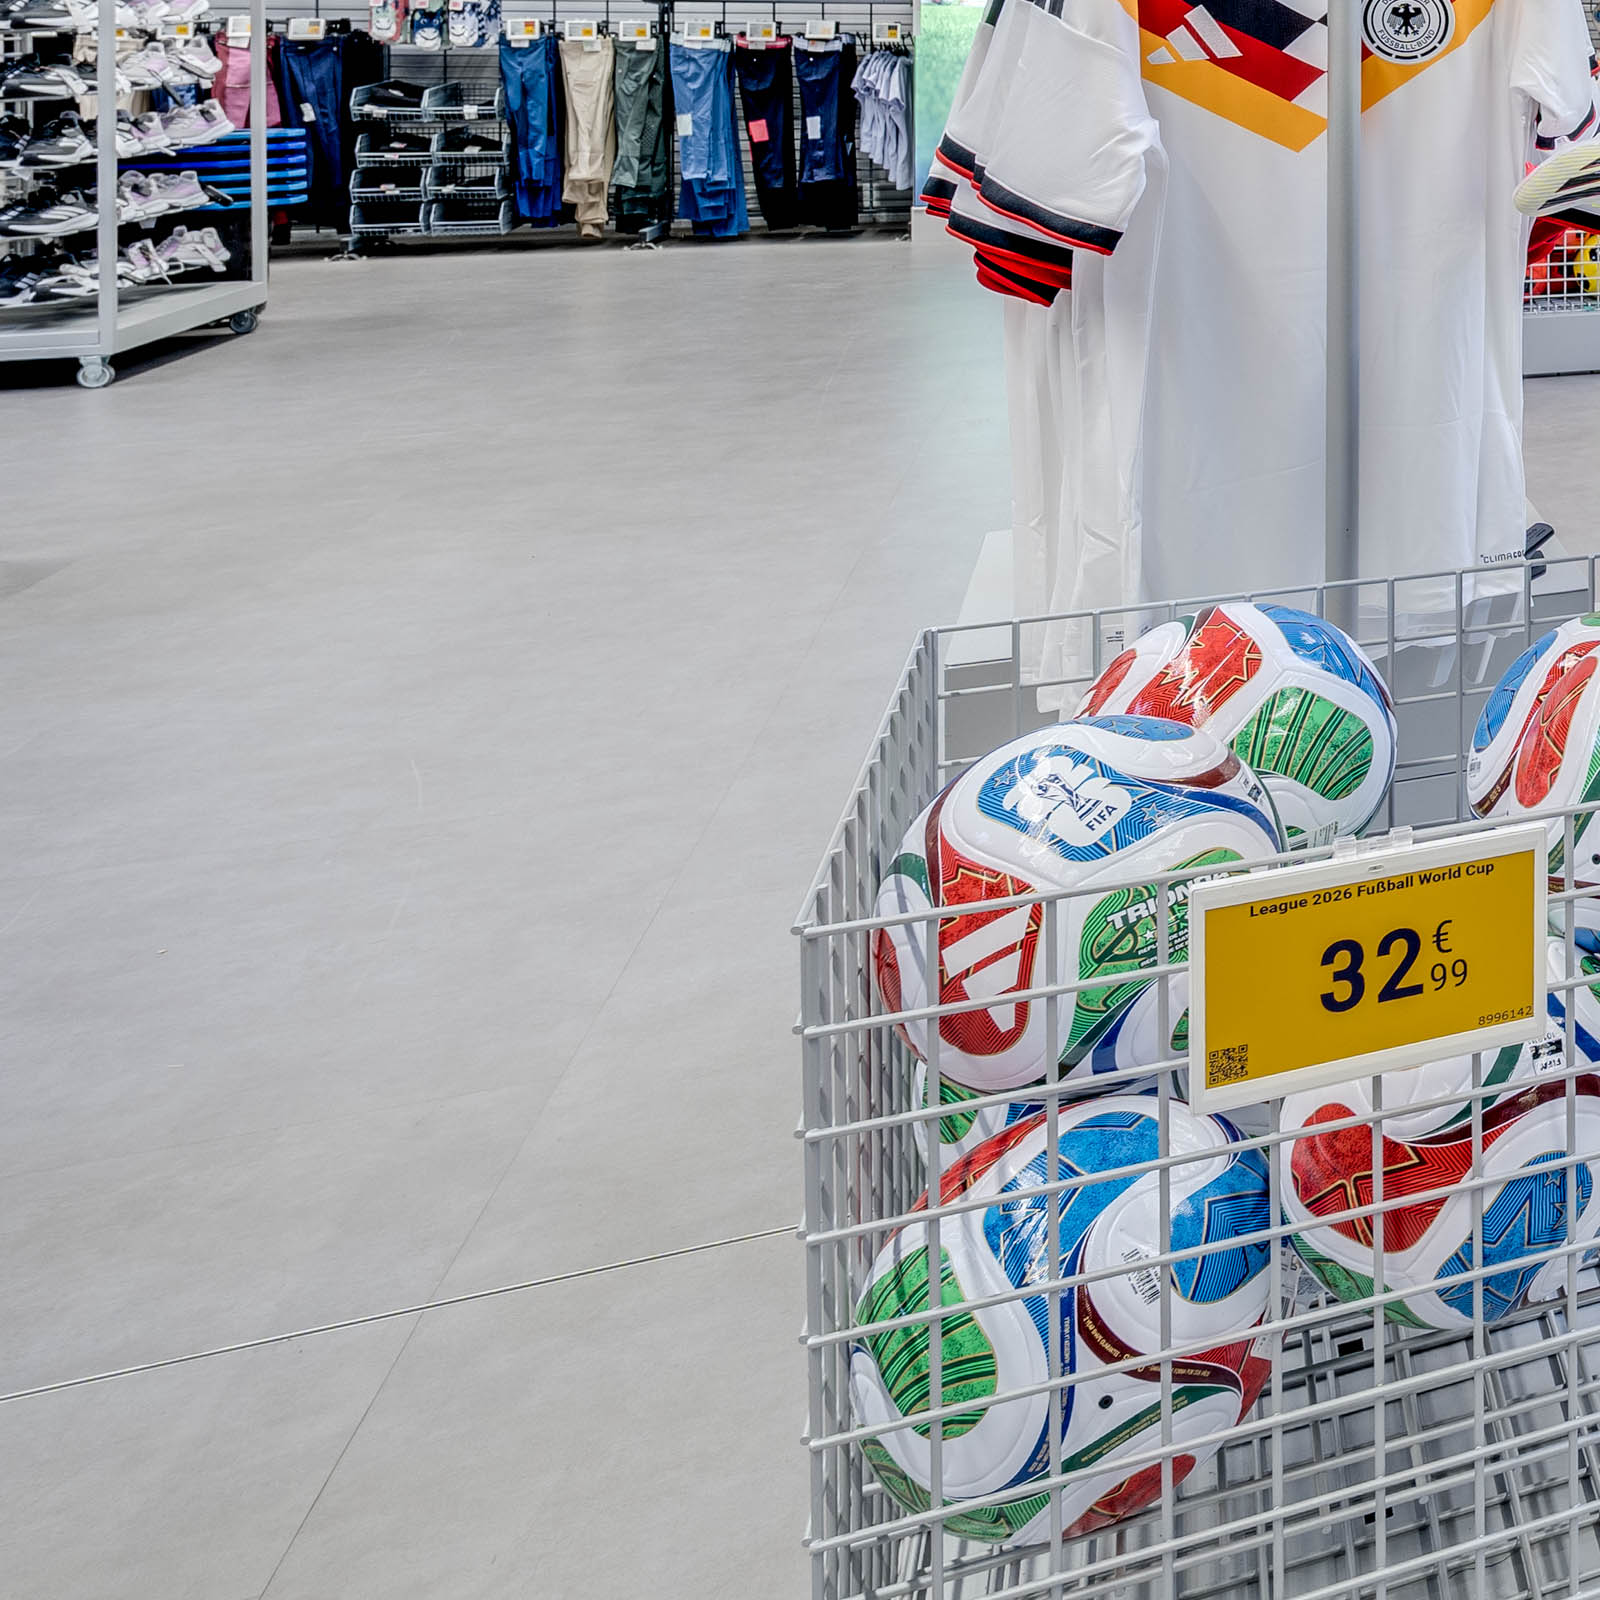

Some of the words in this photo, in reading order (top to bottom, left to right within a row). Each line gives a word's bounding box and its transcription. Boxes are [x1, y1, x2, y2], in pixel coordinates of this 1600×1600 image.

[1377, 28, 1436, 50] FUSSBALL-BUND
[1085, 805, 1118, 831] FIFA
[1249, 897, 1308, 918] League
[1312, 887, 1353, 907] 2026
[1356, 875, 1415, 898] Fußball
[1418, 866, 1462, 886] World
[1465, 861, 1495, 882] Cup
[1432, 919, 1454, 954] €
[1319, 927, 1424, 1013] 32
[1430, 958, 1468, 992] 99
[1478, 1005, 1533, 1026] 8996142
